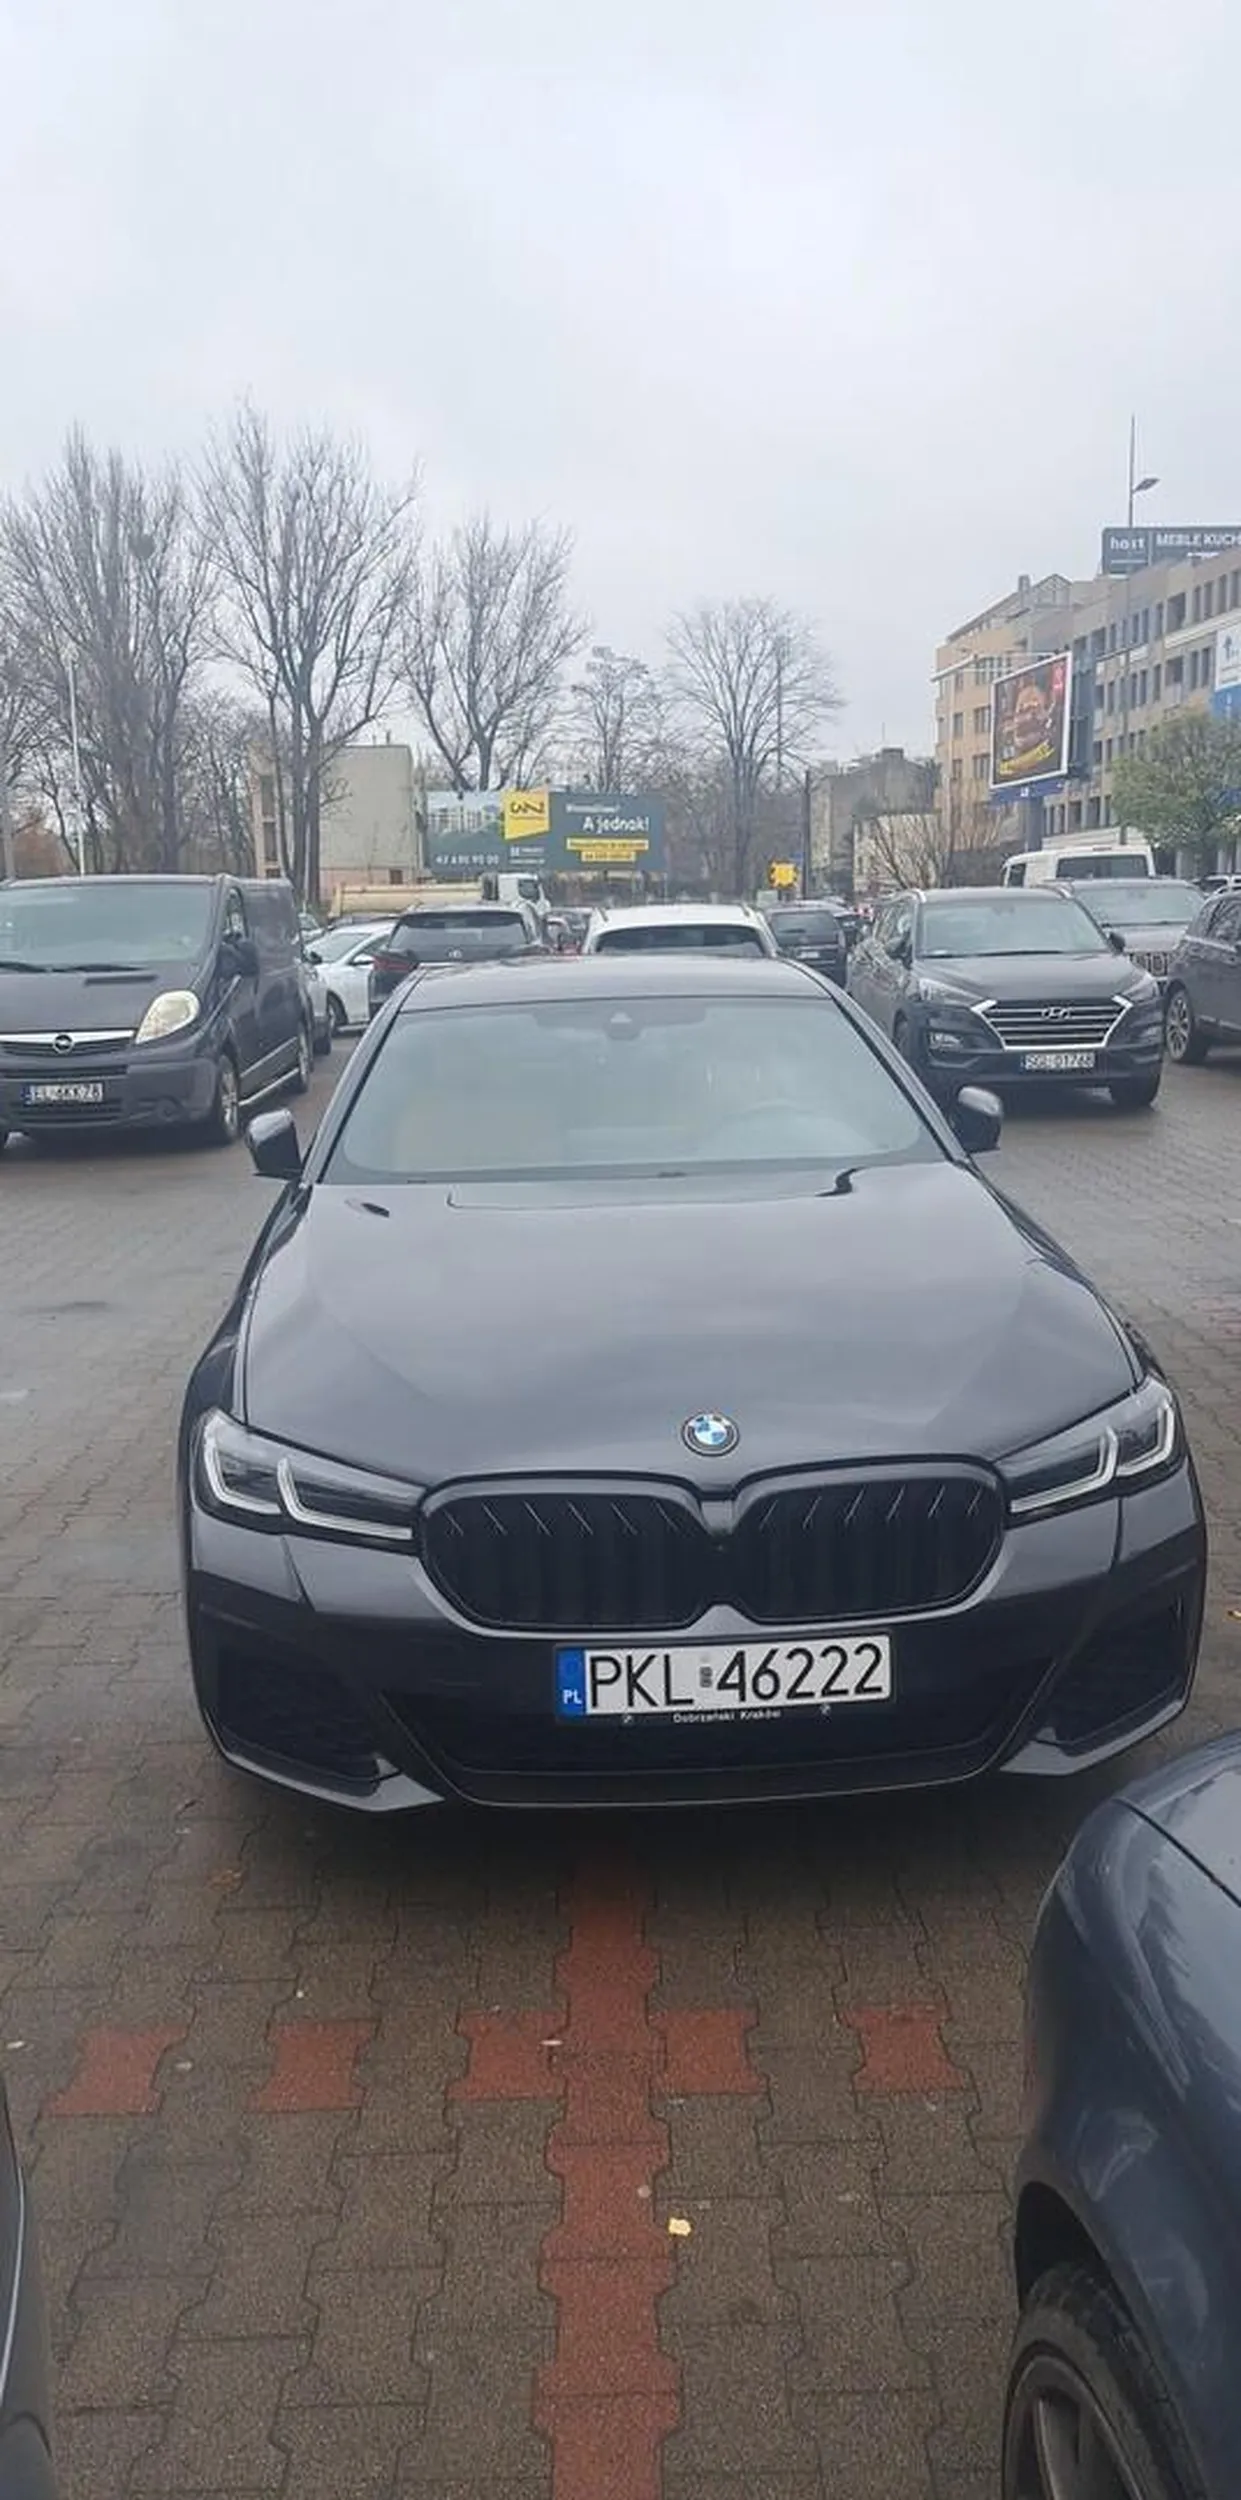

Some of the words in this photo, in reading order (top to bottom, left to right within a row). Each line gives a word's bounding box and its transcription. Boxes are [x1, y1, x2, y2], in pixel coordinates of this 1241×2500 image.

[1156, 533, 1202, 546] MEBLE
[583, 814, 595, 832] A
[596, 814, 650, 835] jednak!
[589, 1655, 695, 1708] PKL
[716, 1642, 884, 1702] 46222
[563, 1689, 583, 1705] PL
